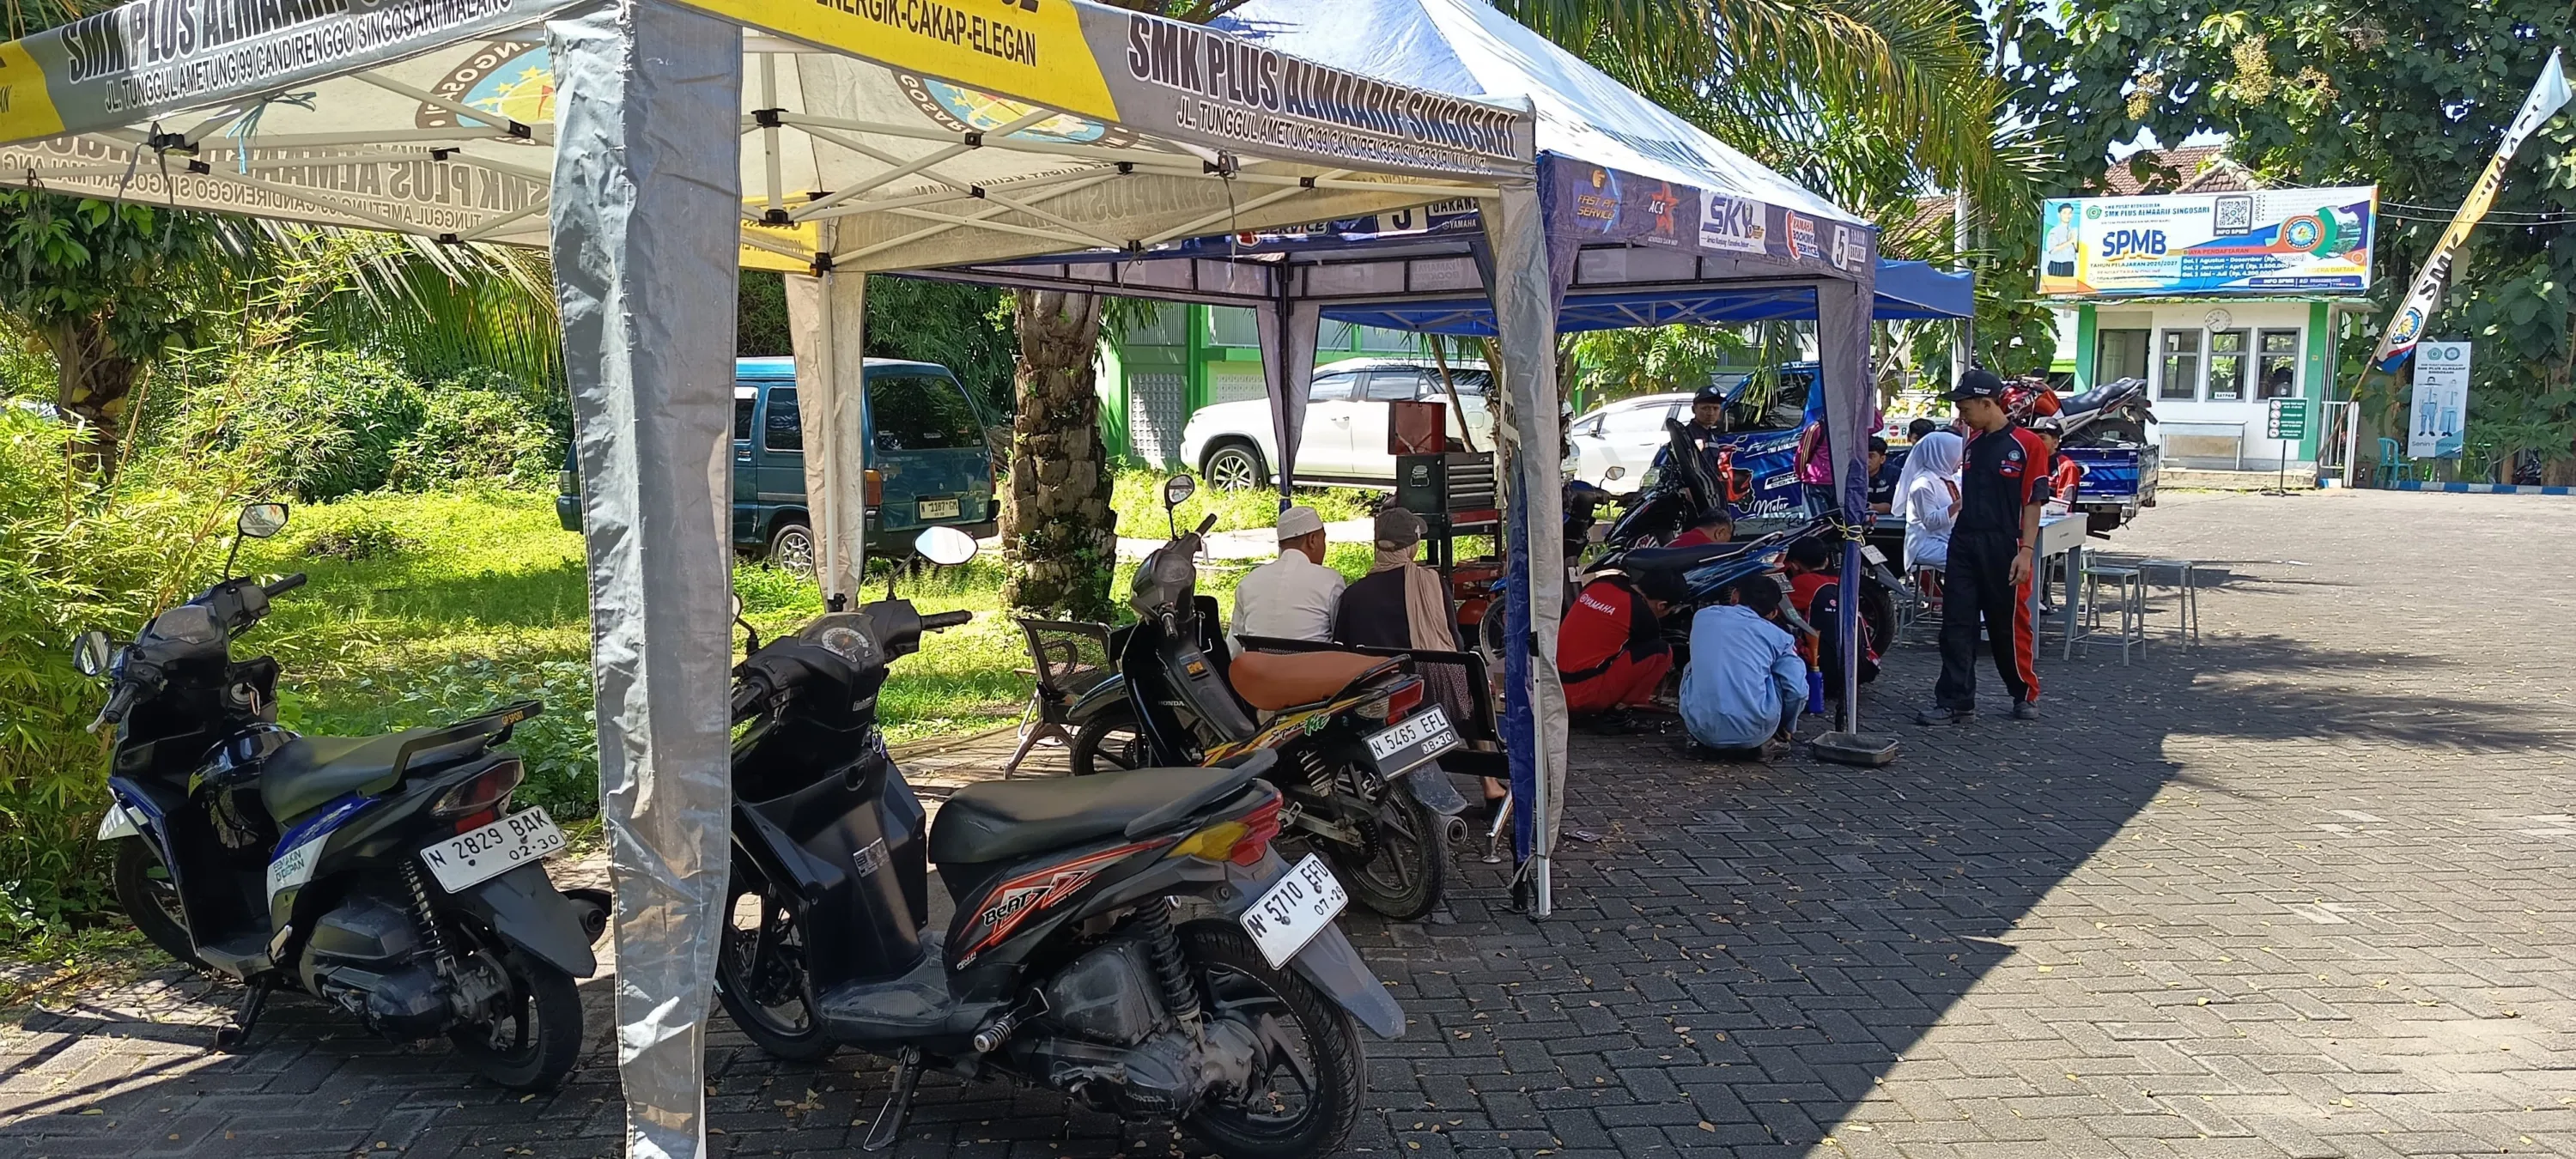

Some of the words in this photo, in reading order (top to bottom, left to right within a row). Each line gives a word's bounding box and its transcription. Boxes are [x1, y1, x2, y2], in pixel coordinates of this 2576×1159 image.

[61, 9, 125, 82] SMK
[129, 0, 196, 69] PLUS
[817, 0, 1036, 66] RGIK-CAKAP-ELEGAN
[106, 81, 122, 112] JL.
[122, 70, 178, 107] TUNGGUL
[179, 53, 237, 96] AMETUNG
[239, 47, 254, 81] 99
[257, 21, 354, 76] CANDIRENGGO
[358, 2, 440, 51] SINGOSARI
[1128, 14, 1202, 94] SMK
[1208, 34, 1279, 111] PLUS
[1285, 58, 1405, 137] ALMAARIF
[1406, 91, 1518, 161] SINGOSARI
[1177, 96, 1196, 128] JL.
[1200, 103, 1258, 139] TUNGGUL
[1260, 116, 1314, 152] AMETUNG
[1315, 128, 1329, 153] 99
[1331, 132, 1404, 167] CANDIRENGGO
[1577, 195, 1601, 206] FAST
[1577, 206, 1616, 220] SERVICE
[1649, 200, 1666, 215] ACS
[2172, 206, 2210, 215] SINGOSARI
[1449, 219, 1477, 228] YAMAHA
[1701, 195, 1753, 239] SKY
[1793, 218, 1814, 233] YAMAHA
[1792, 229, 1814, 245] BOOKING
[1796, 242, 1819, 257] SERVICE
[1836, 229, 1845, 266] 5
[2102, 228, 2166, 258] SPMB
[920, 504, 926, 513] N
[949, 501, 958, 511] GM
[1753, 495, 1789, 517] Motor
[1584, 596, 1616, 616] YAMAHA
[1371, 740, 1384, 757] N
[1384, 725, 1417, 750] 5465
[1420, 712, 1446, 733] EFL
[428, 849, 447, 869] N
[452, 828, 503, 859] 2829
[507, 810, 550, 837] BAK
[1247, 913, 1267, 938] N
[1263, 881, 1303, 924] 5710
